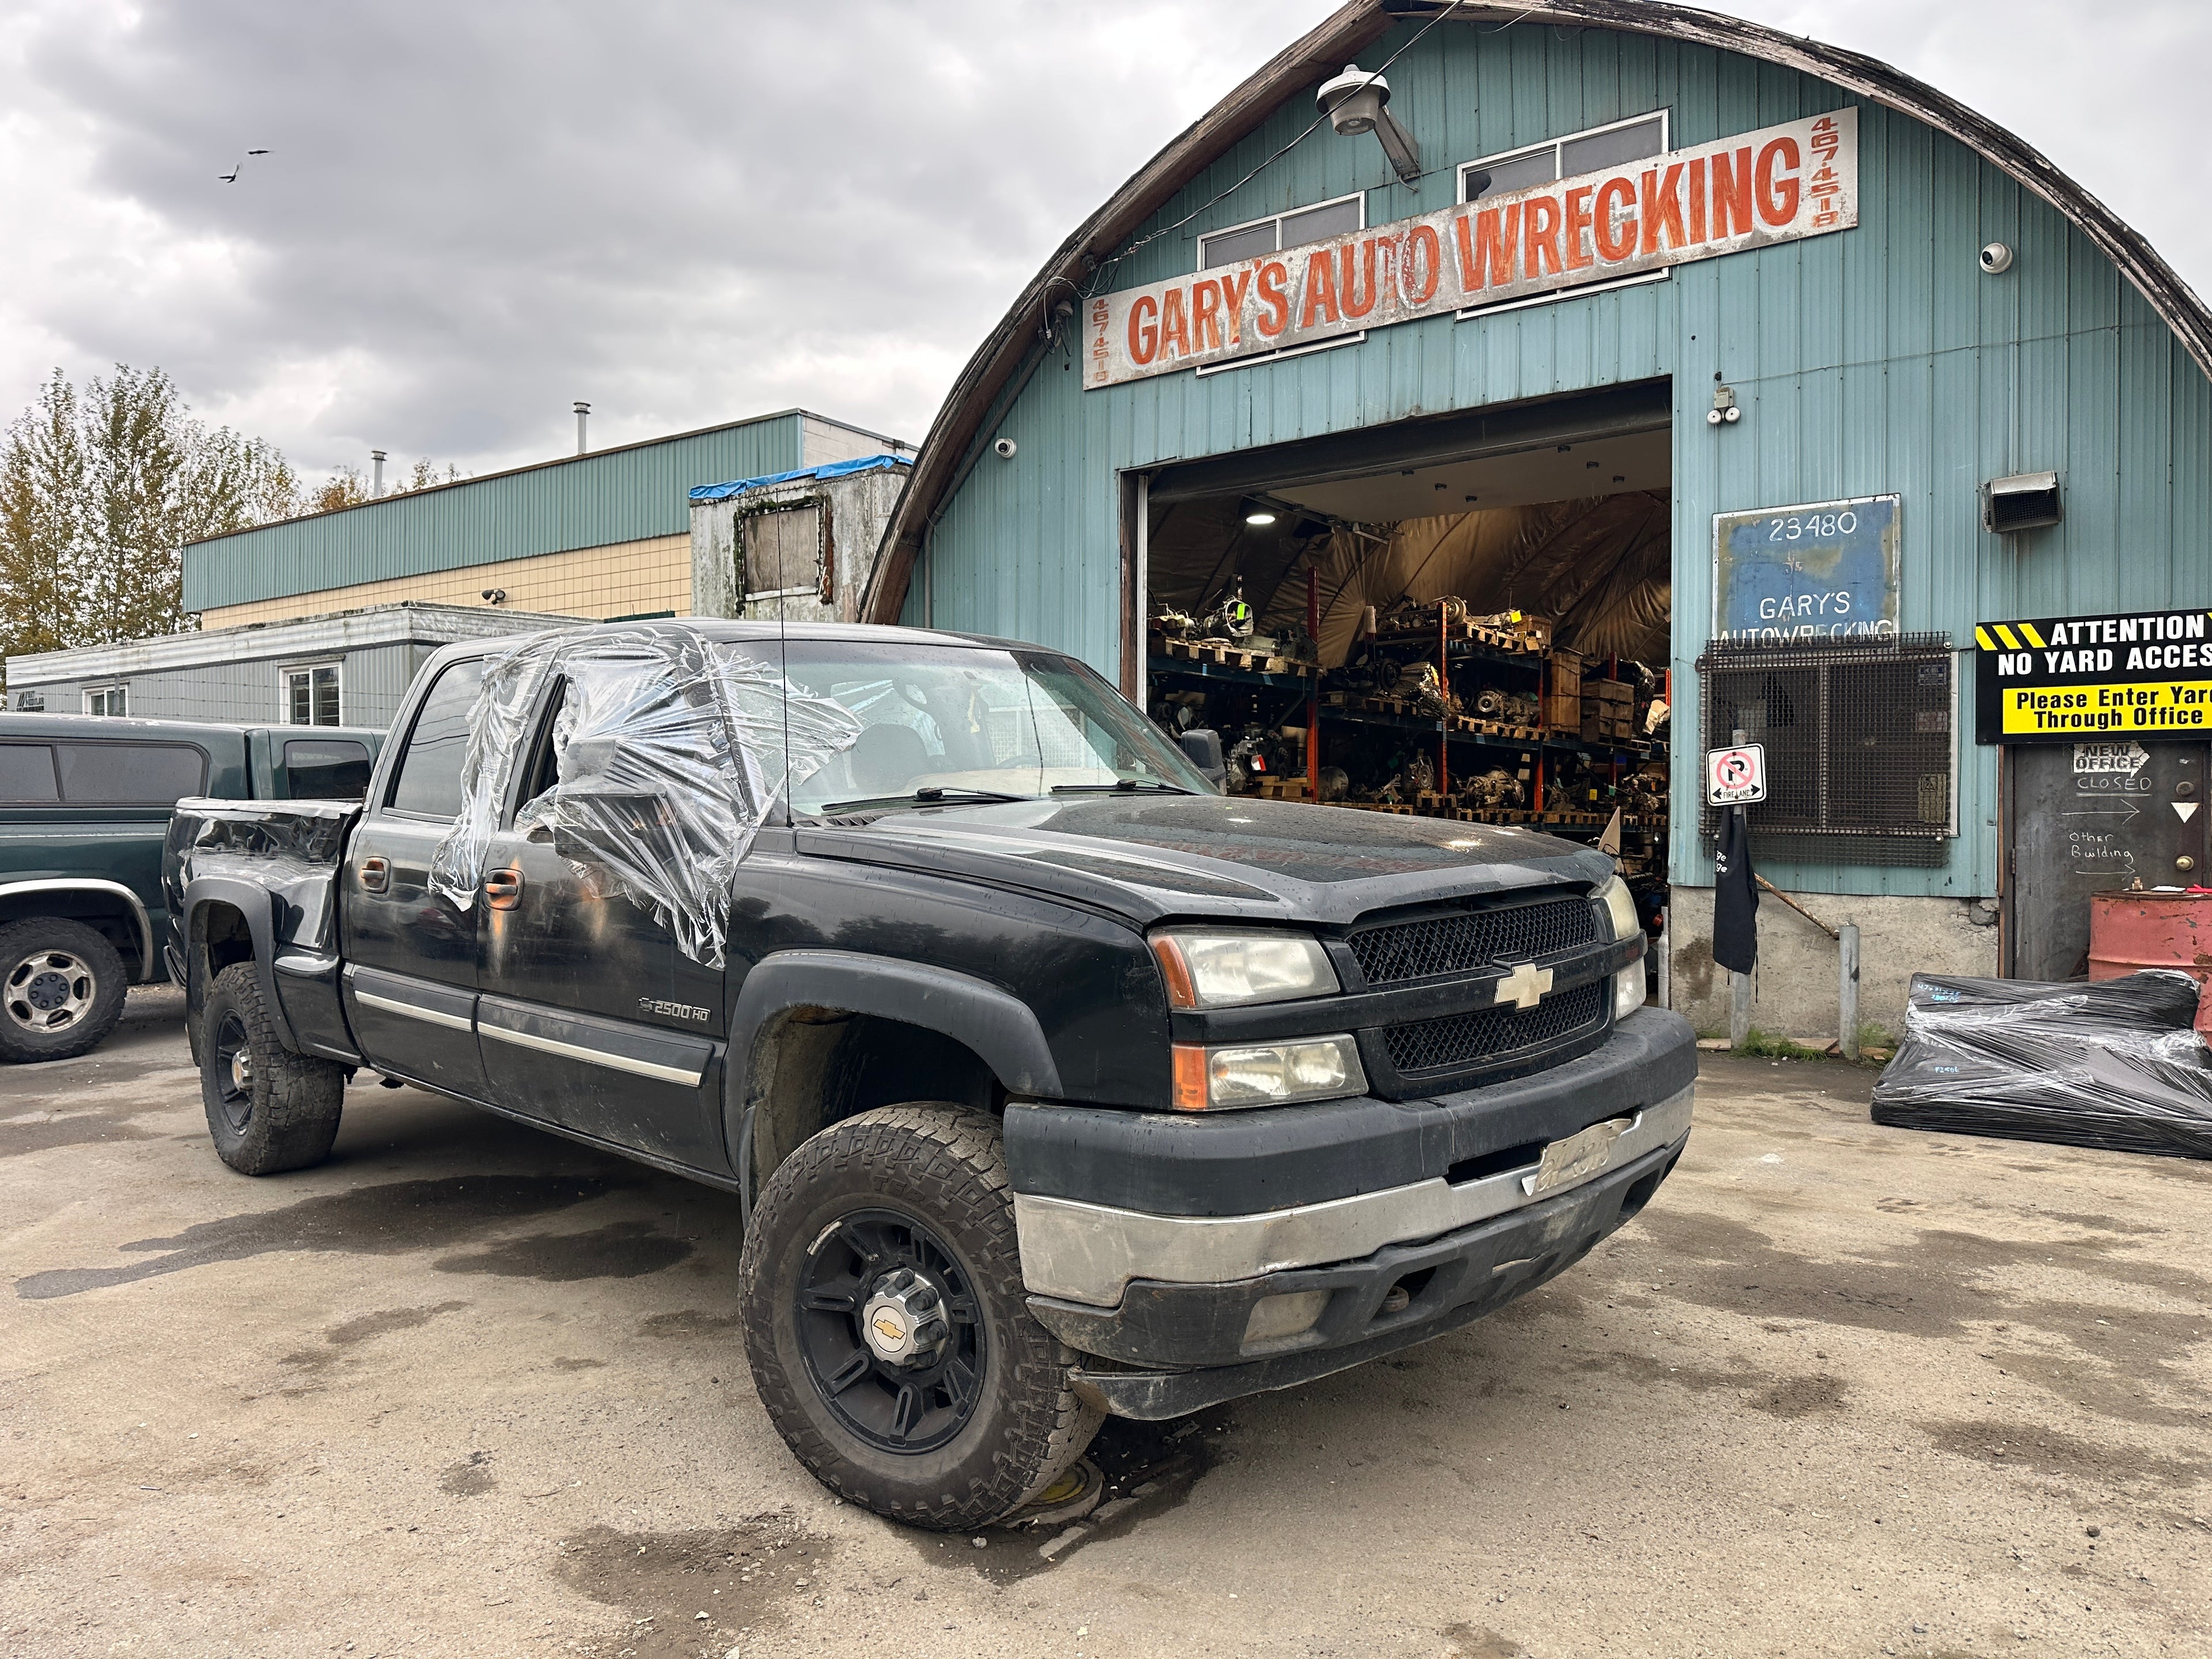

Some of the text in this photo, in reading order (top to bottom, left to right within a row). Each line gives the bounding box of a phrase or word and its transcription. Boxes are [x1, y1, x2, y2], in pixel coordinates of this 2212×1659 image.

[1127, 137, 1801, 365] GARY'S AUTO WRECKING
[1769, 511, 1857, 541] 23480
[1760, 591, 1850, 620] GARY'S
[2051, 614, 2204, 646] ATTENTION
[1998, 653, 2032, 676] NO
[2044, 649, 2113, 673] YARD
[2017, 686, 2212, 710] Please Enter Yar
[2034, 707, 2203, 729] Through Office
[2085, 744, 2130, 756] NEW
[2075, 756, 2140, 770] OFFICE
[2077, 776, 2152, 790] CLOSED
[1723, 791, 1734, 799] FIRE
[2071, 844, 2134, 865] Building
[654, 1001, 709, 1021] 2500 HD
[872, 1175, 965, 1240] TERRA
